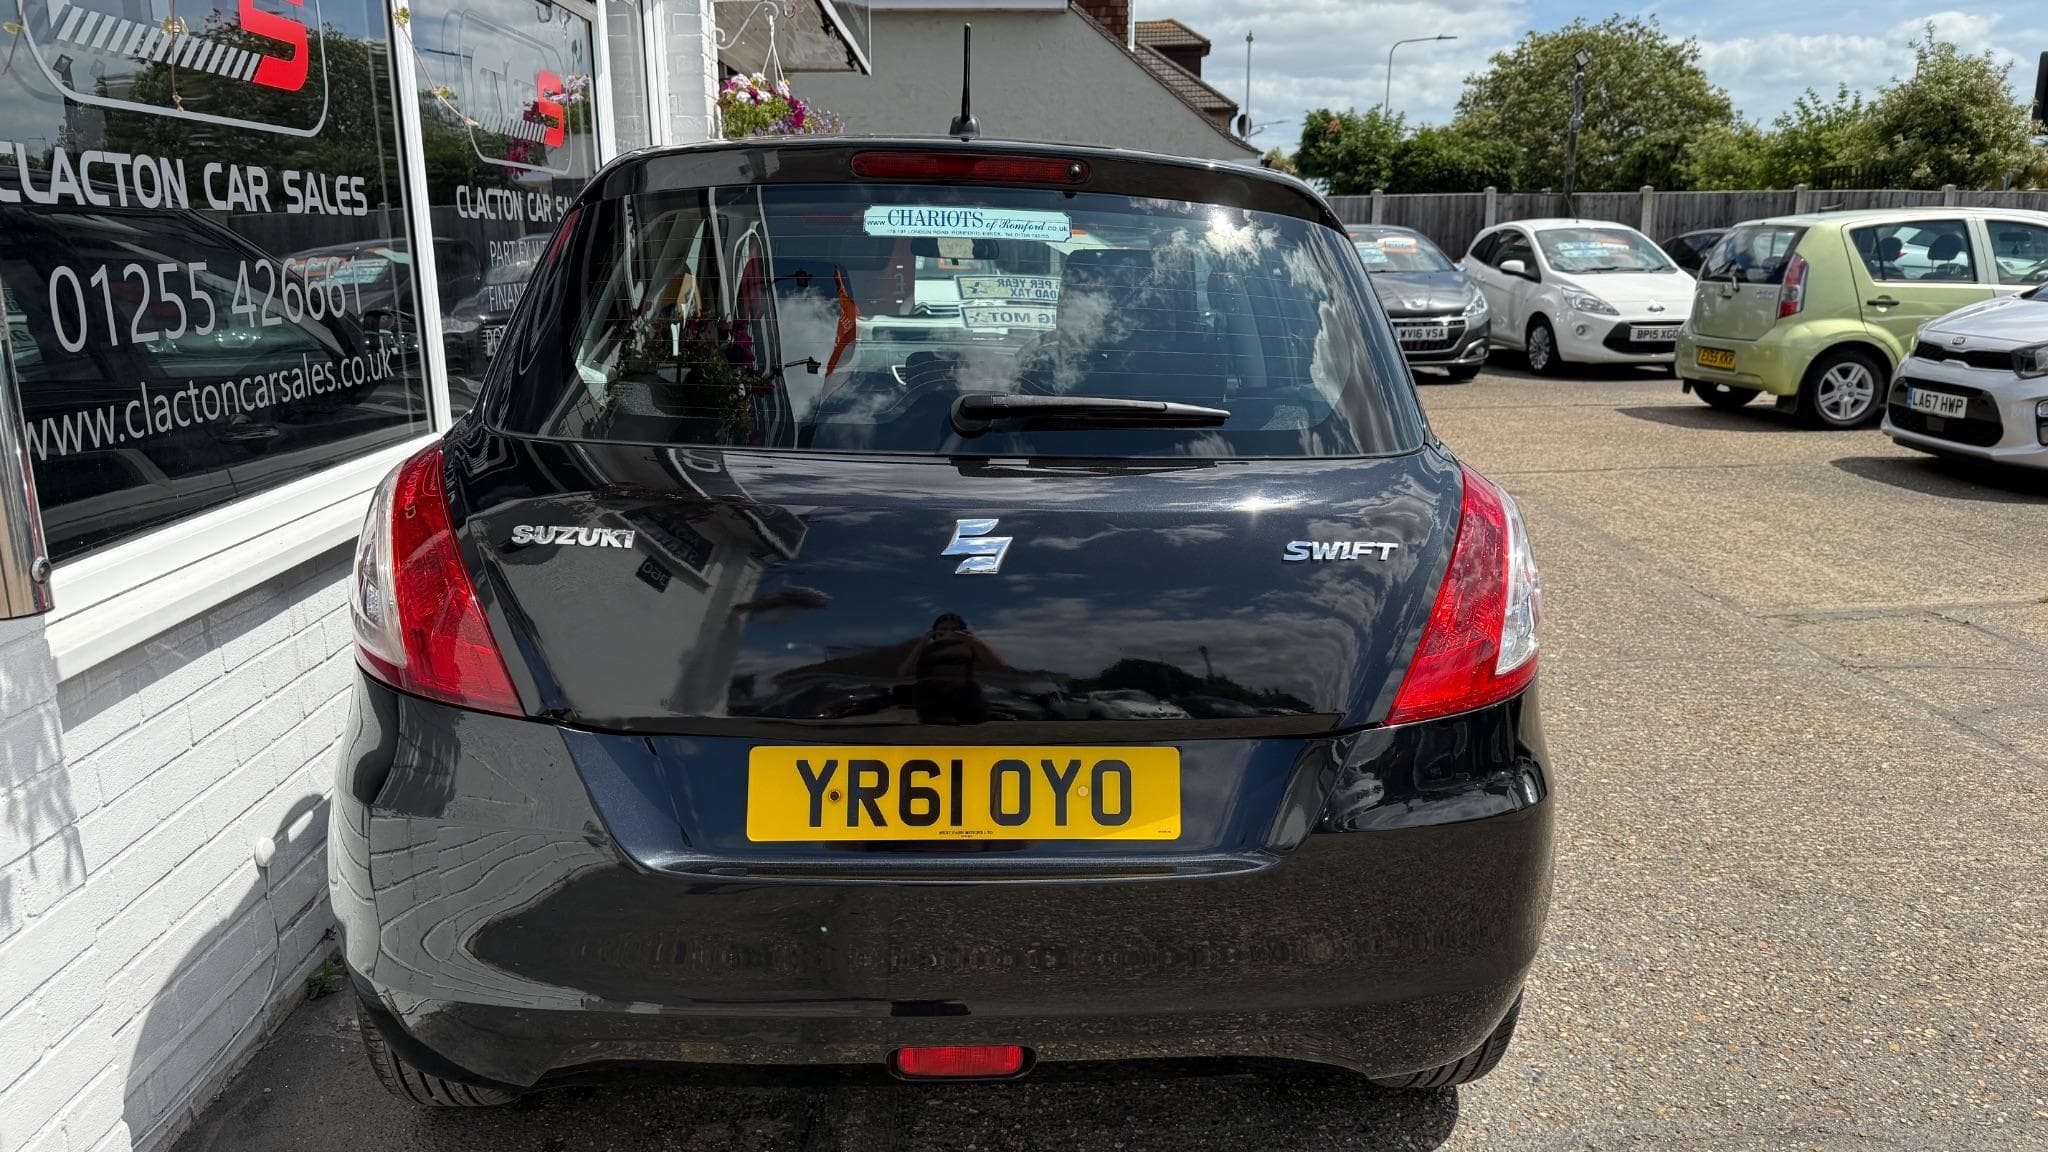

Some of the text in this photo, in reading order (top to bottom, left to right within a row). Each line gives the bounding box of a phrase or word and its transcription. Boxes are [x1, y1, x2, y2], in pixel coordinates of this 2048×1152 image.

[203, 162, 272, 213] CAR
[282, 169, 368, 216] SALES
[456, 185, 524, 222] CLACTON
[527, 192, 553, 223] CAR
[887, 208, 984, 228] CHARIOTS
[985, 221, 997, 231] of
[998, 218, 1046, 232] Romford
[489, 239, 516, 267] PART
[518, 240, 531, 264] EX
[49, 262, 216, 353] 01255
[231, 255, 362, 329] 426661
[488, 284, 528, 312] FINAN
[1425, 328, 1445, 338] VSA
[23, 349, 394, 461] www.clactoncarsales.co.uk
[1912, 391, 1964, 414] LA67 HWP
[511, 524, 635, 549] SUZUKI
[1283, 540, 1399, 561] SWIFT
[796, 759, 1132, 828] YR61 OYO
